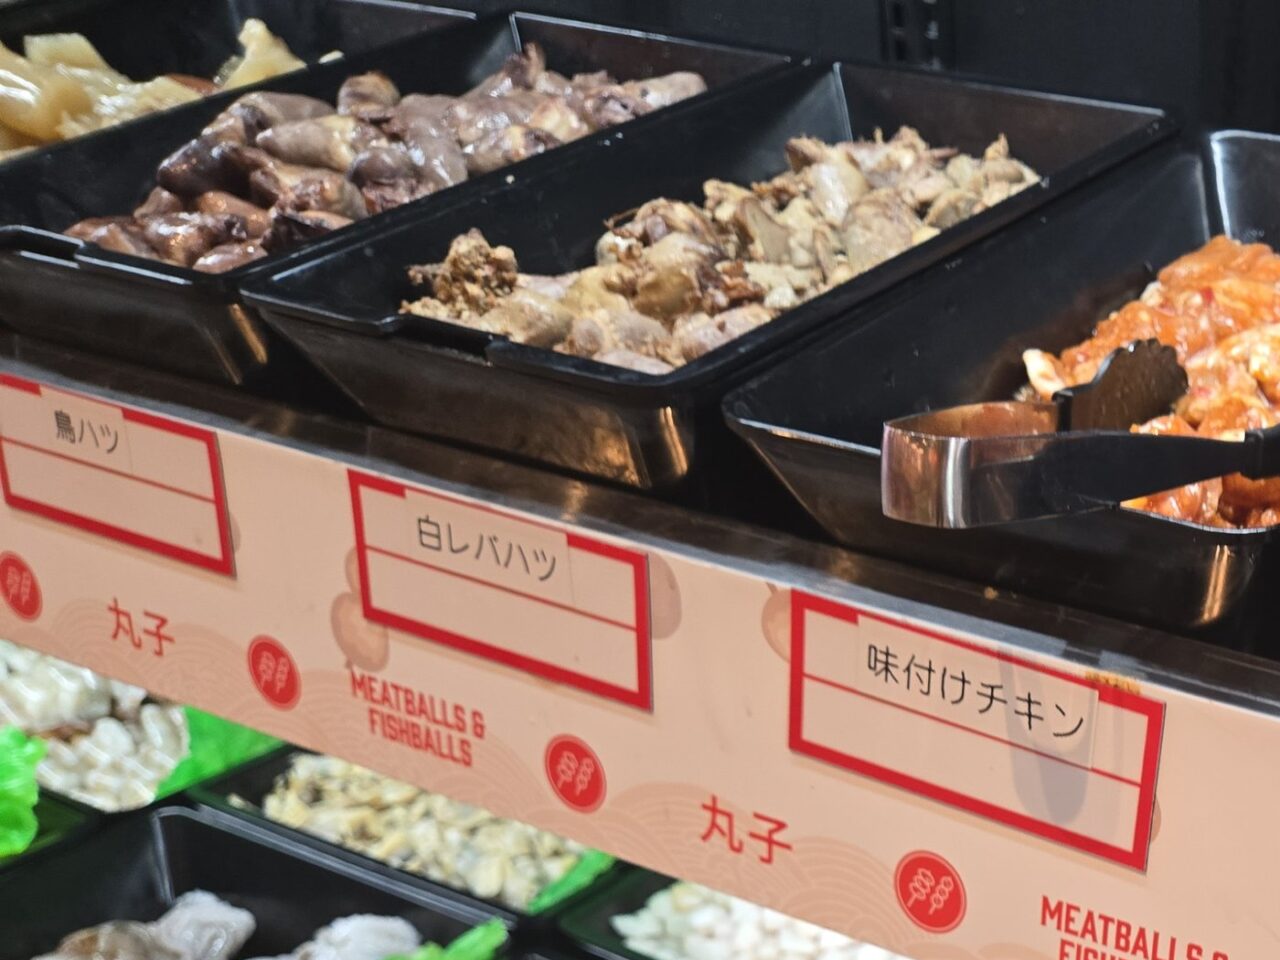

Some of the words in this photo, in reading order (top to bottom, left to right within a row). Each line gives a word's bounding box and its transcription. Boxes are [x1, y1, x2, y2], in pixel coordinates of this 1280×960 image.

[417, 515, 557, 582] 白レバハツ
[107, 597, 175, 658] 丸子
[351, 671, 466, 733] MEATBALLS
[472, 710, 485, 739] &
[867, 644, 1085, 738] 味付けチキン
[368, 707, 472, 767] FISHBALLS
[699, 795, 793, 865] 丸子
